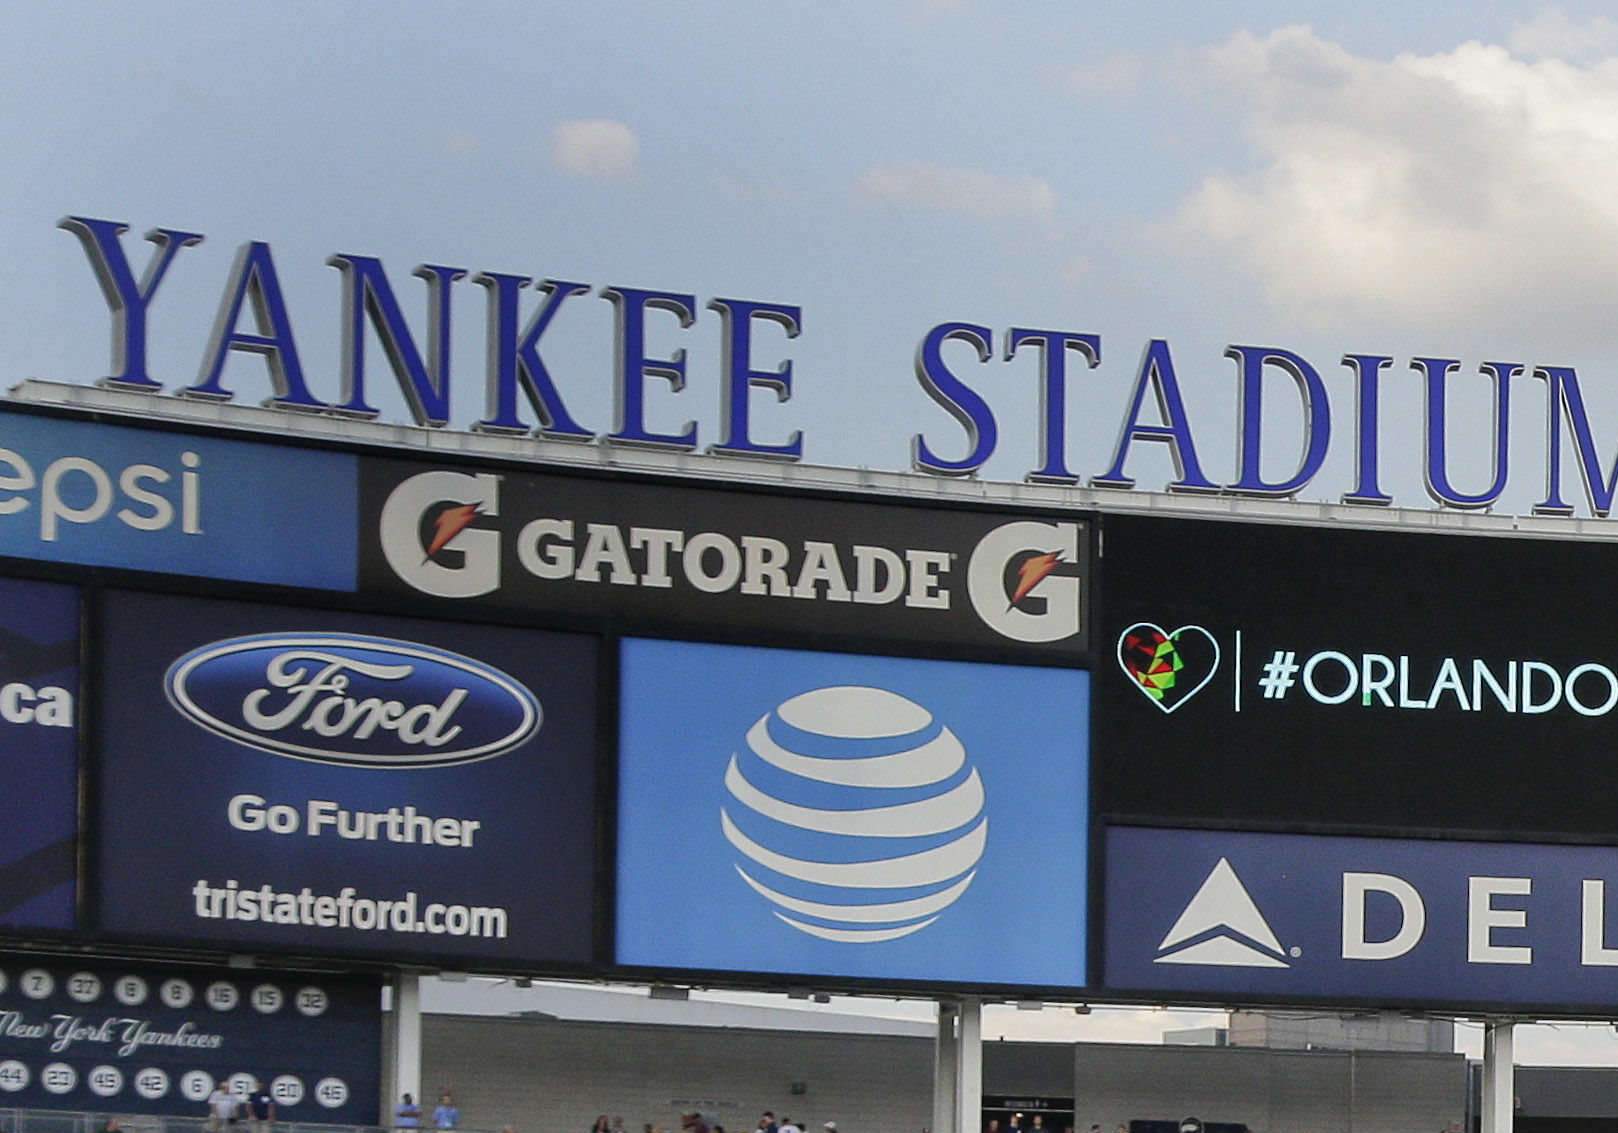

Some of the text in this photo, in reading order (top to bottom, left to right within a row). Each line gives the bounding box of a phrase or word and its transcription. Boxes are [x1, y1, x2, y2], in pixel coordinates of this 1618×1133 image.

[56, 214, 804, 460] YANKEE
[517, 518, 950, 609] GATORADE
[243, 650, 469, 746] Ford
[228, 794, 480, 847] Go Further
[193, 880, 508, 938] tristateford.com
[117, 1017, 224, 1057] Yankees
